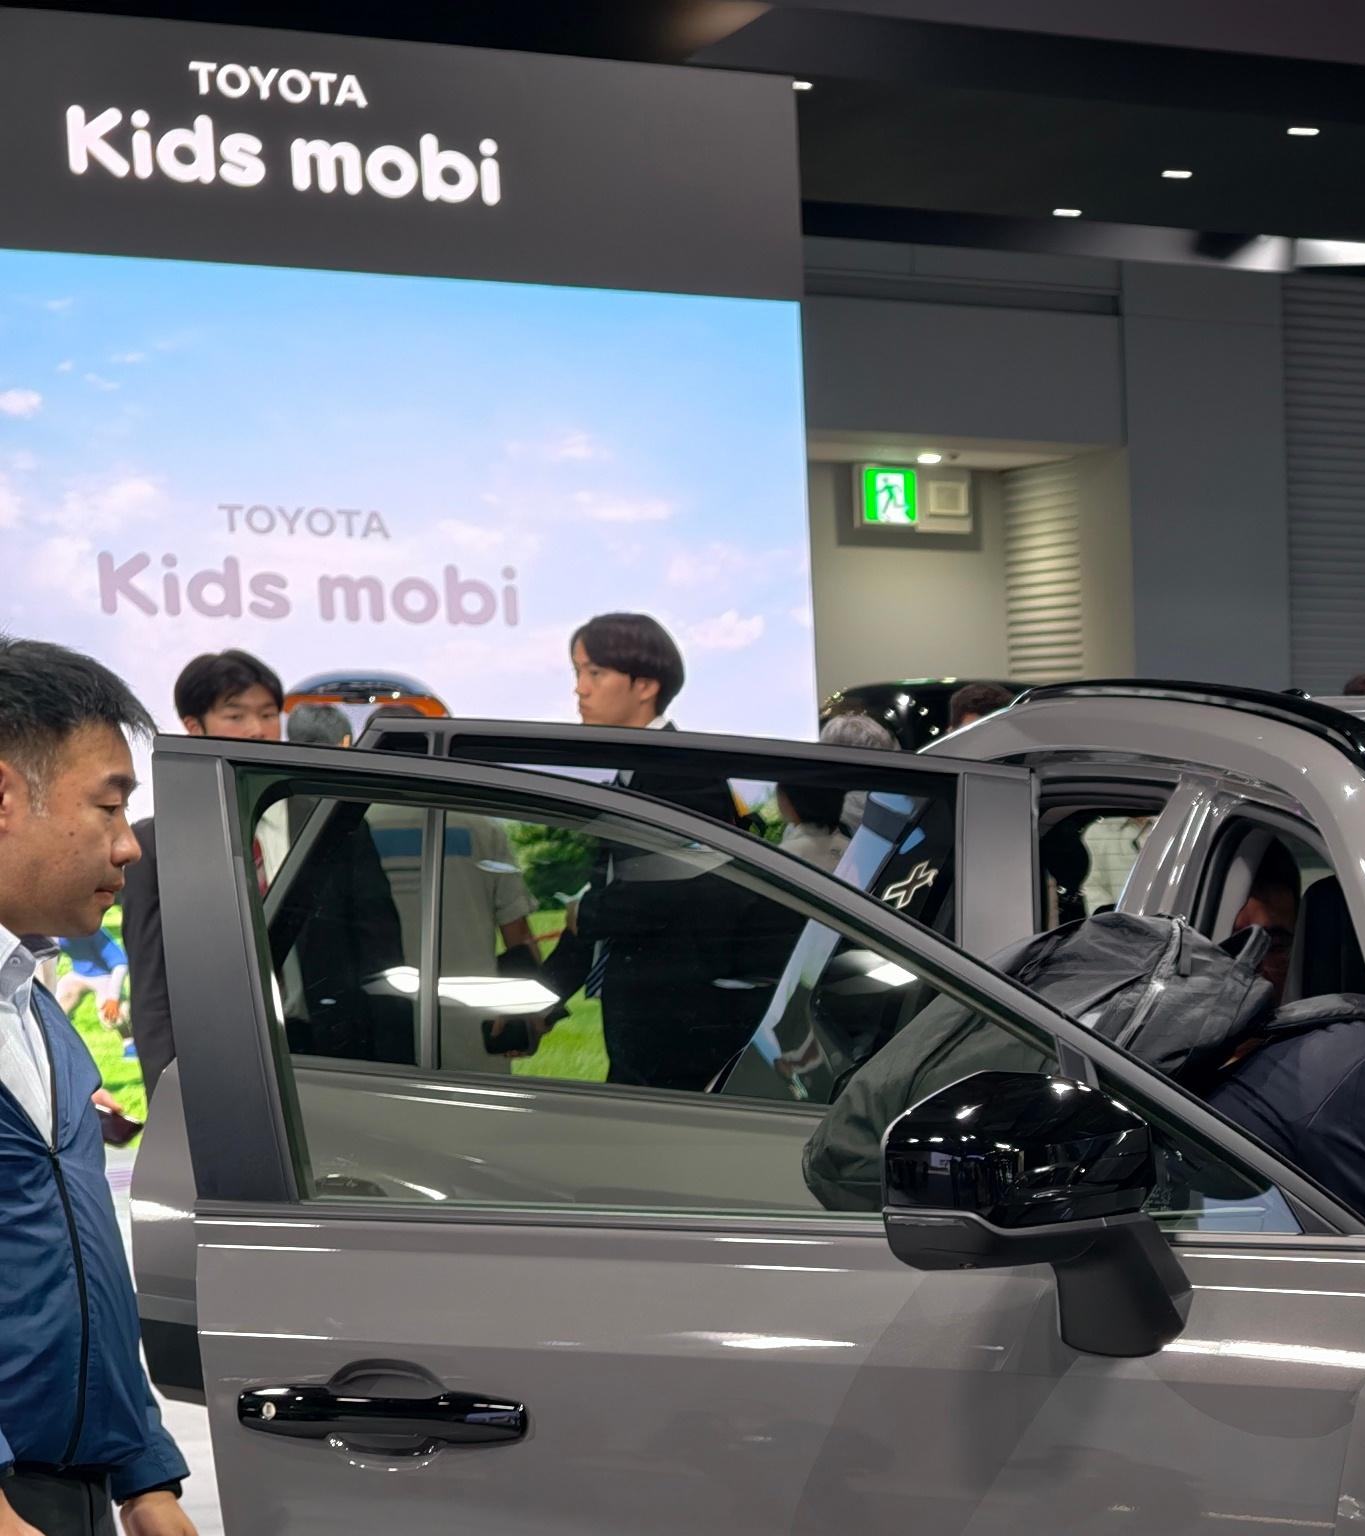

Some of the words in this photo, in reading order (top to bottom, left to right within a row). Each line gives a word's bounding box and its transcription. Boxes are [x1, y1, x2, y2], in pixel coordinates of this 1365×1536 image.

[188, 60, 369, 109] TOYOTA
[65, 104, 267, 187] Kids
[290, 132, 501, 206] mobi
[216, 503, 393, 541] TOYOTA
[96, 549, 292, 620] Kids
[317, 563, 519, 628] mobi
